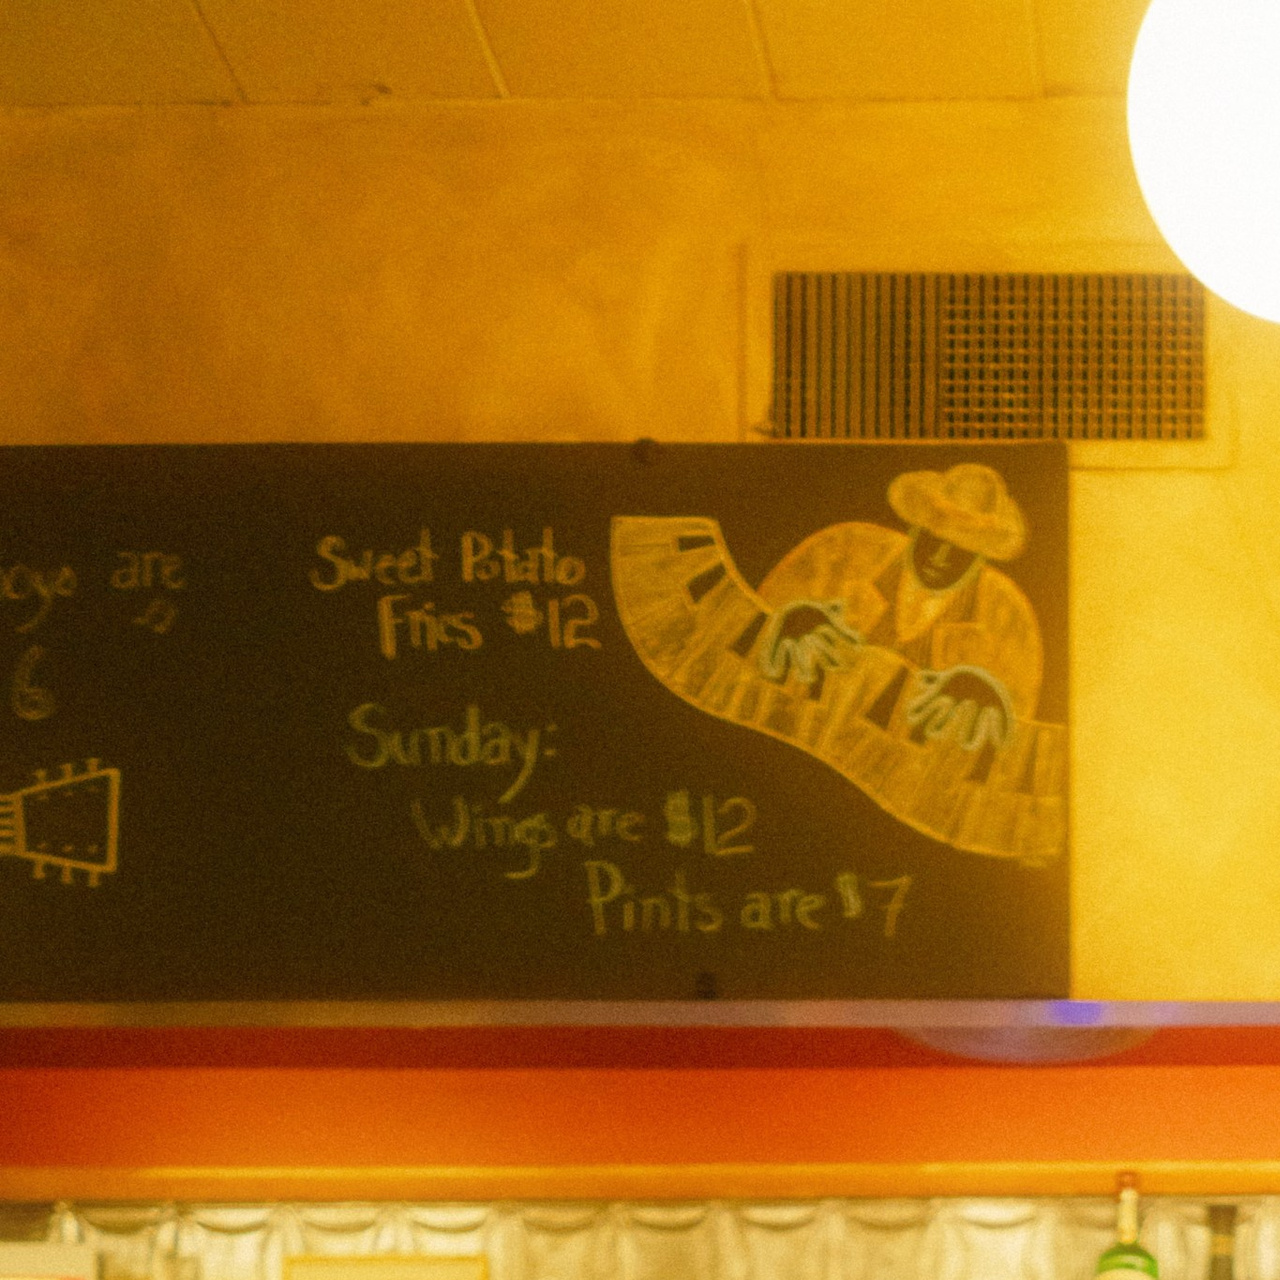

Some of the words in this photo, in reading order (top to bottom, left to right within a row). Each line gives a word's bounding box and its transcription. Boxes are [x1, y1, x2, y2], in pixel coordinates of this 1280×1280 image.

[110, 551, 186, 590] are
[310, 527, 438, 592] Sweet
[460, 526, 586, 584] Potato
[376, 592, 484, 660] Fries
[409, 797, 558, 880] Wings
[565, 803, 642, 847] are
[585, 859, 723, 936] Pints
[739, 888, 828, 931] are
